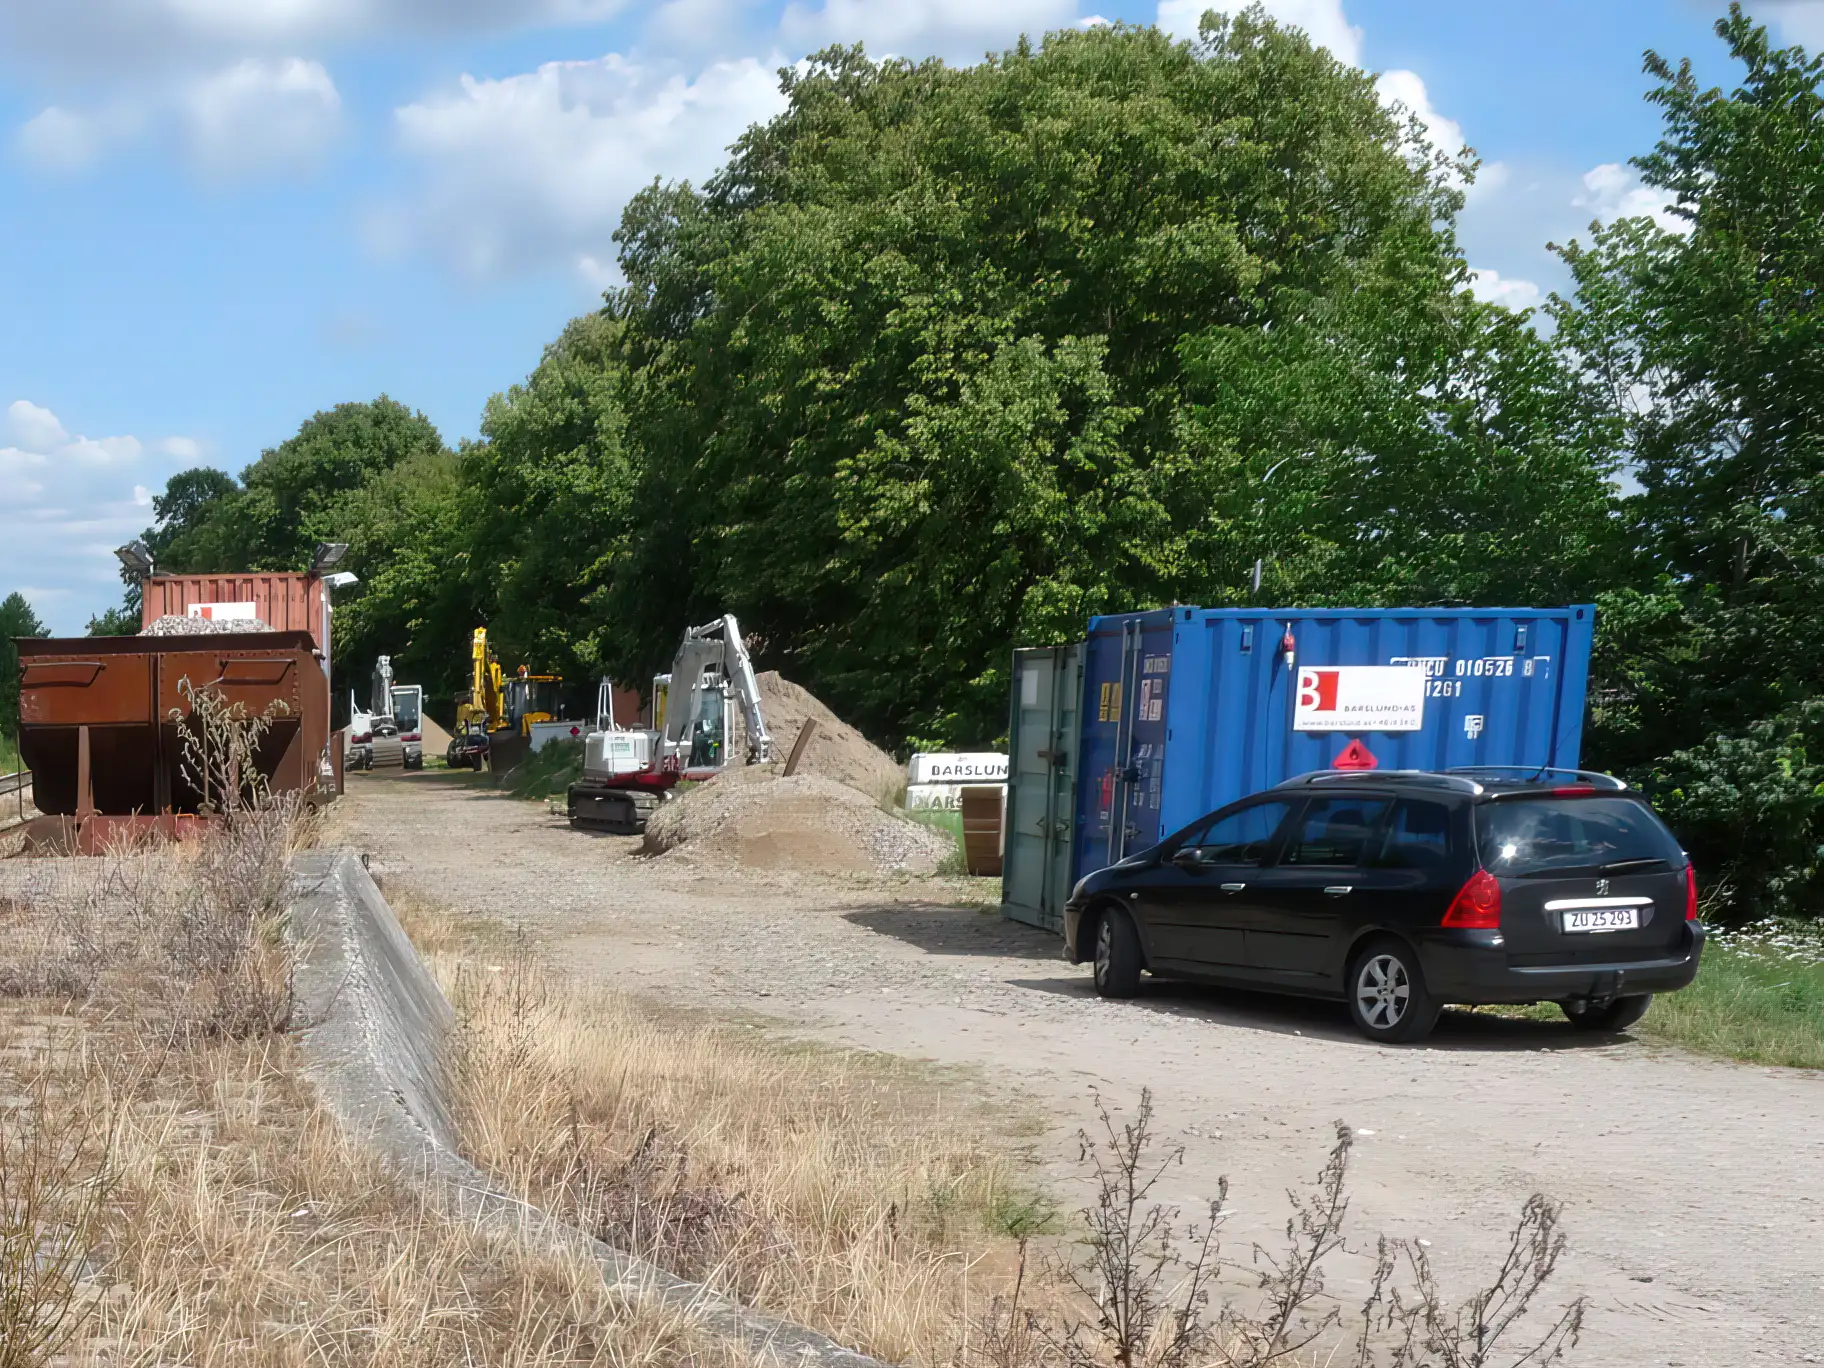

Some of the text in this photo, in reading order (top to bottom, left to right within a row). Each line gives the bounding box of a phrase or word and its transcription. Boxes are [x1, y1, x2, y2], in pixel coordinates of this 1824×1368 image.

[1299, 670, 1321, 712] B
[1572, 910, 1632, 927] ZU 25 293
